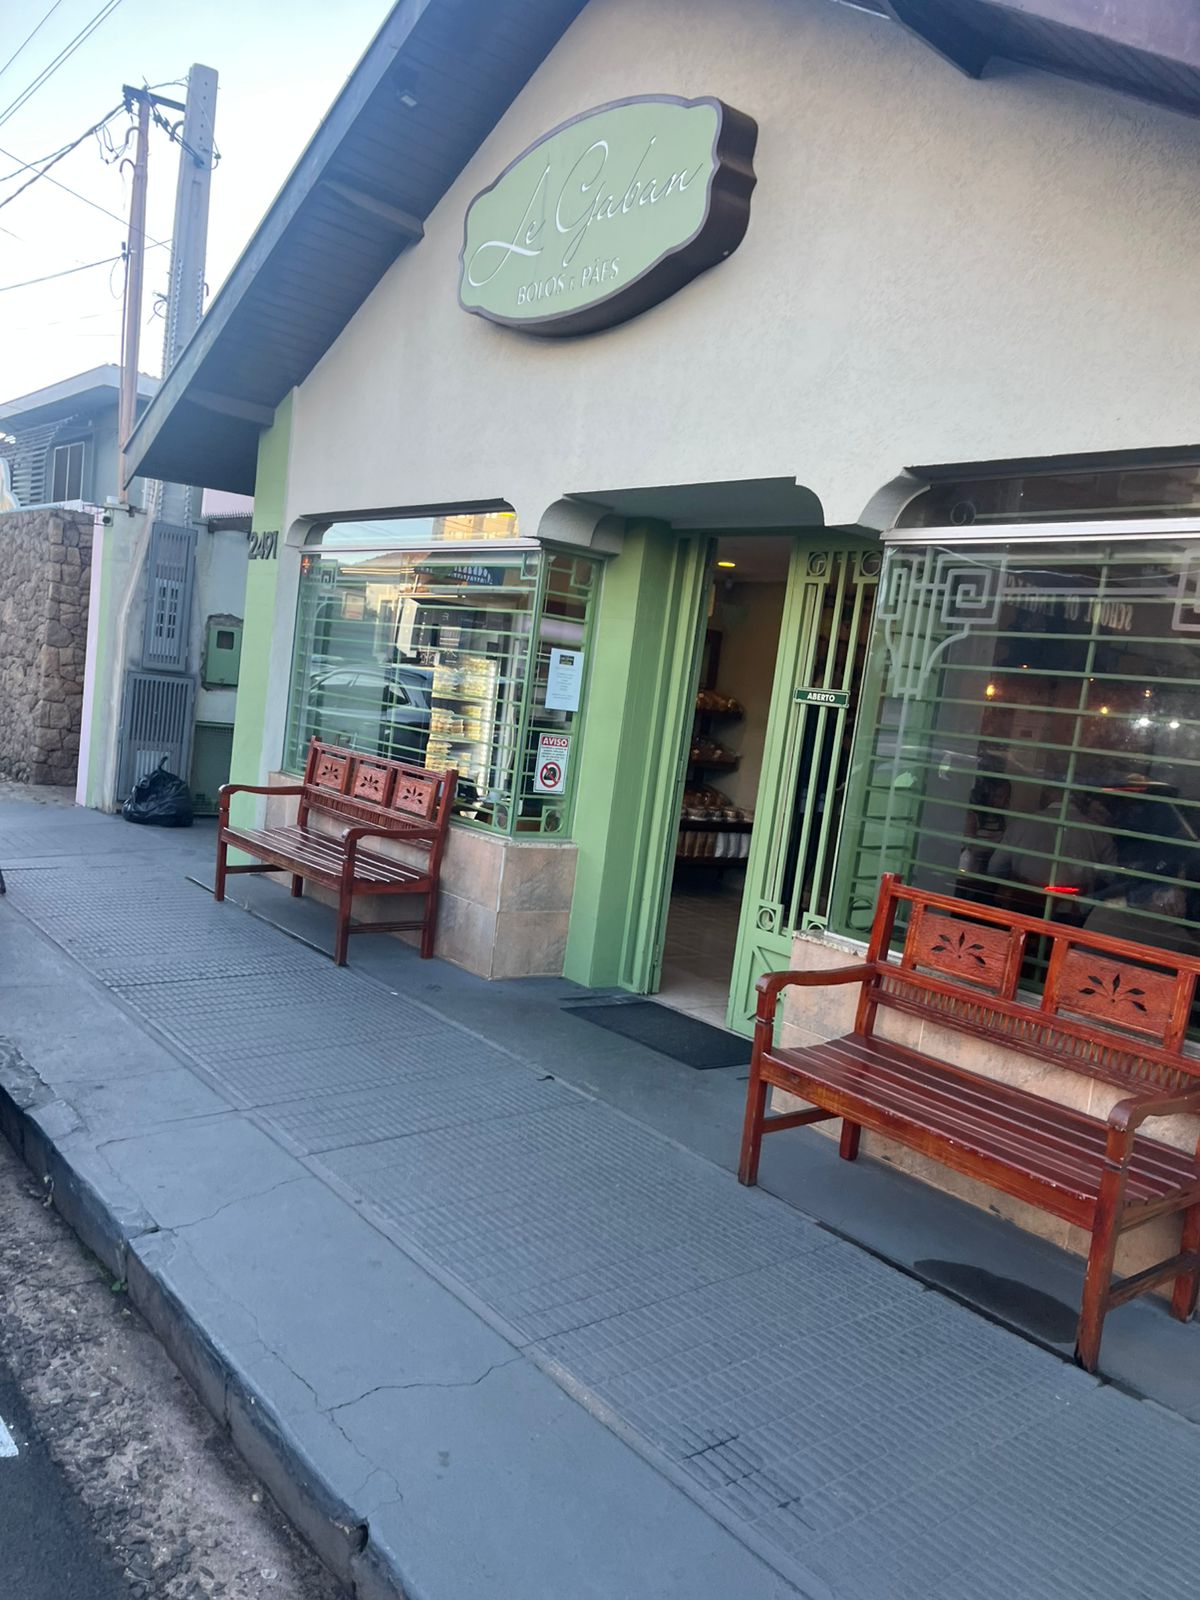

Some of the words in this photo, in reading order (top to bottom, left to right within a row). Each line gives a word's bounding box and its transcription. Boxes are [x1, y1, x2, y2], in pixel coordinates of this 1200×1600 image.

[468, 162, 551, 287] Le
[555, 134, 705, 268] Gaban
[517, 272, 566, 305] BOLOS
[248, 530, 279, 560] 2491
[807, 692, 836, 702] ABERTO
[543, 737, 568, 746] AVISO
